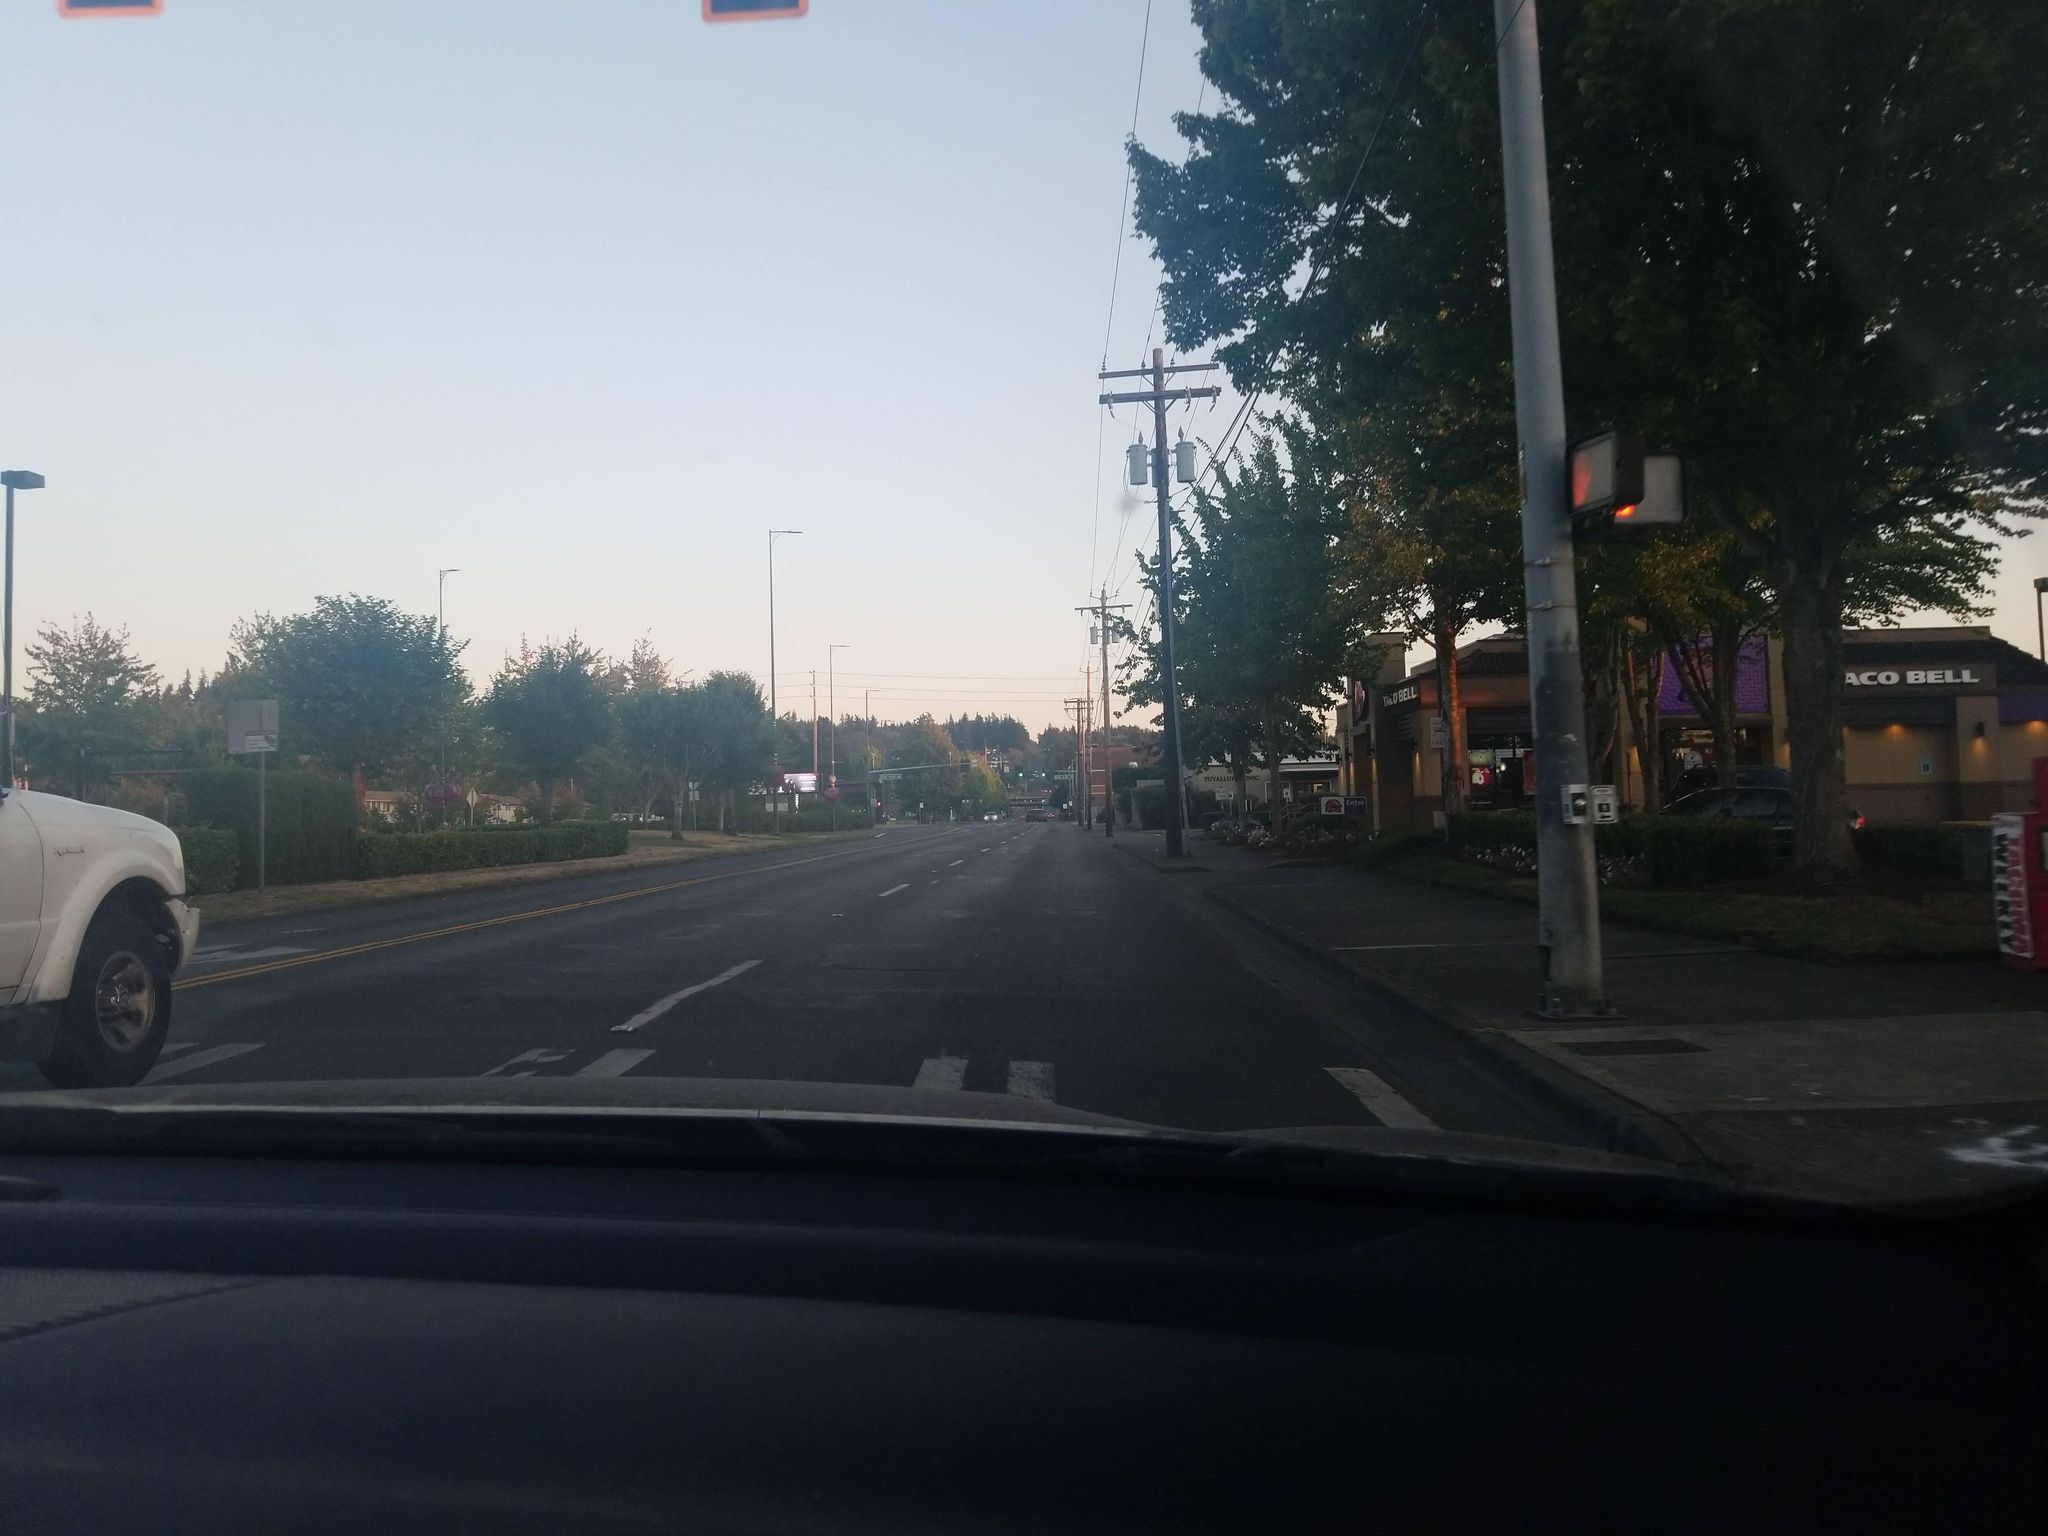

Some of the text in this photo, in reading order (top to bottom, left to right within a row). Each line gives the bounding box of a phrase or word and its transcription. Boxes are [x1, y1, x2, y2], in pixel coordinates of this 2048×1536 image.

[1844, 669, 1980, 686] ACO BELL
[1398, 686, 1417, 703] BELL
